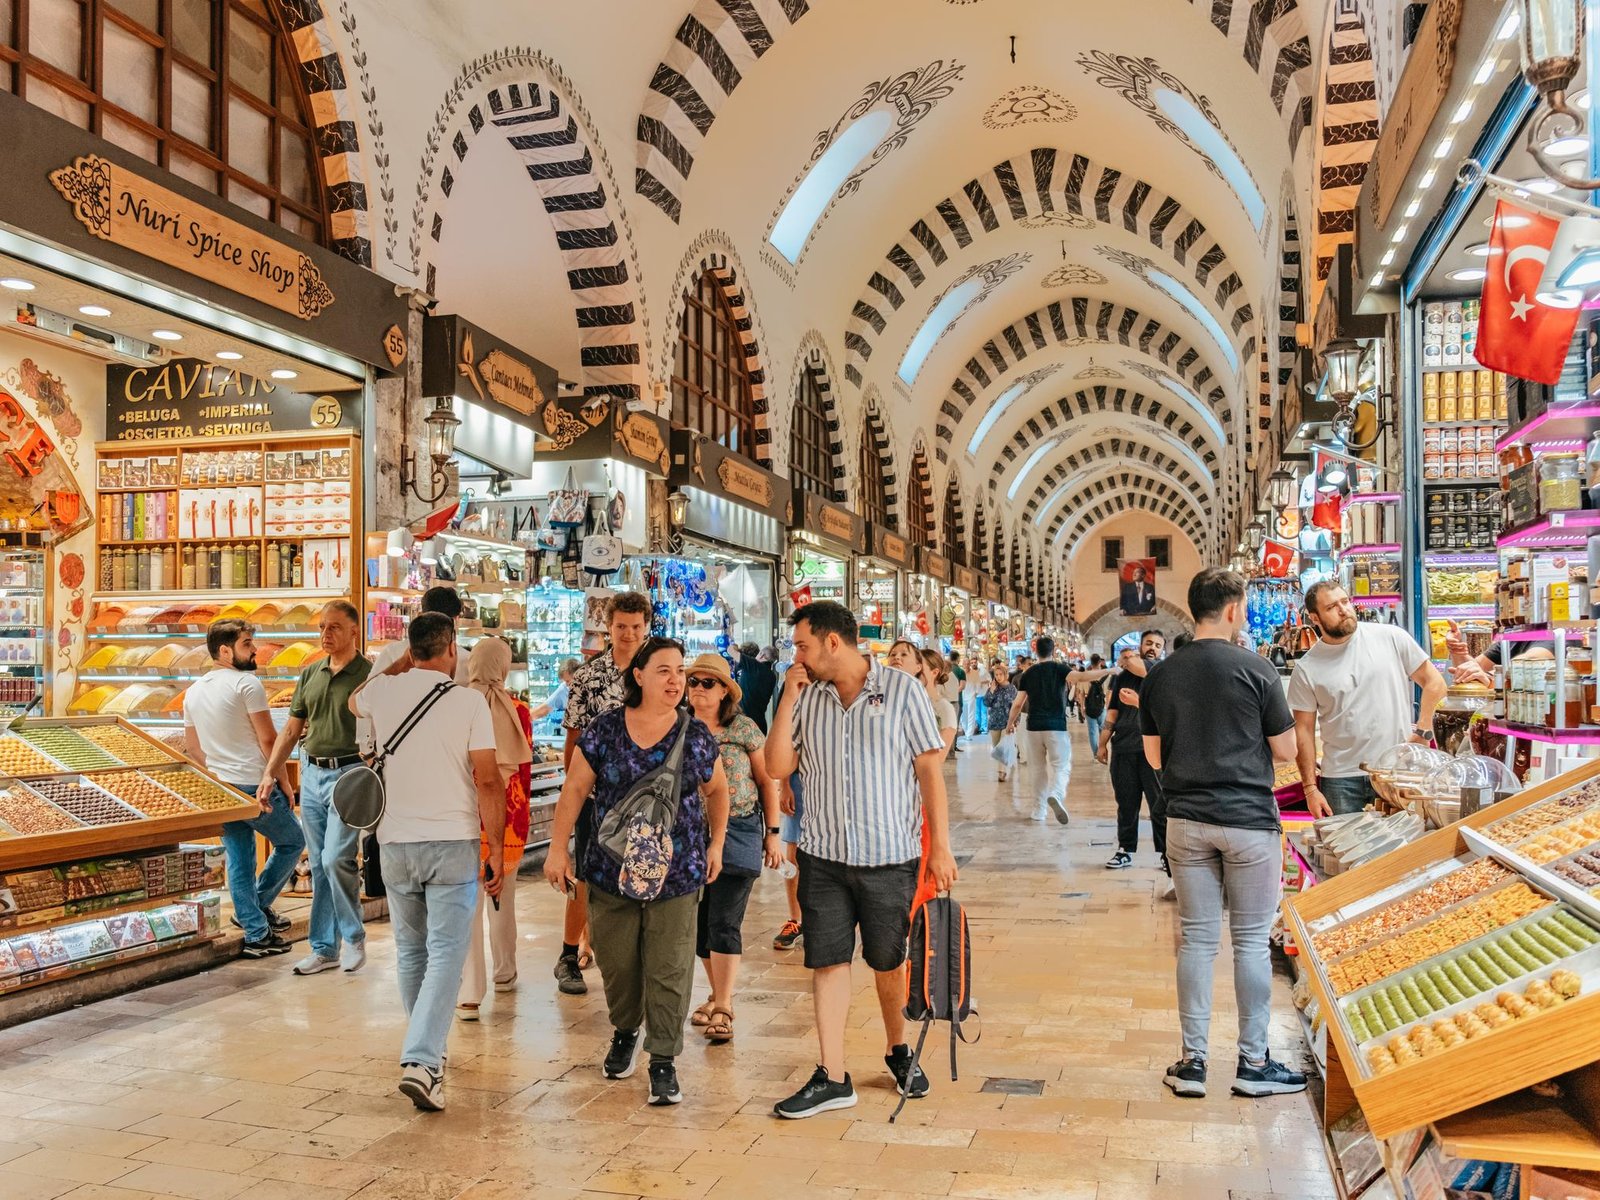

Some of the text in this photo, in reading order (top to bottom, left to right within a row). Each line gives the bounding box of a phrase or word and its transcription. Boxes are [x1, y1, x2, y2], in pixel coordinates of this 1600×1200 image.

[117, 192, 294, 293] Nuri Spice Shop
[390, 334, 403, 355] 55
[126, 408, 180, 423] BELUGA
[205, 403, 273, 418] IMPERIAL
[316, 405, 338, 425] 55
[125, 426, 193, 440] OSCIETRA
[204, 421, 272, 437] SEVRUGA
